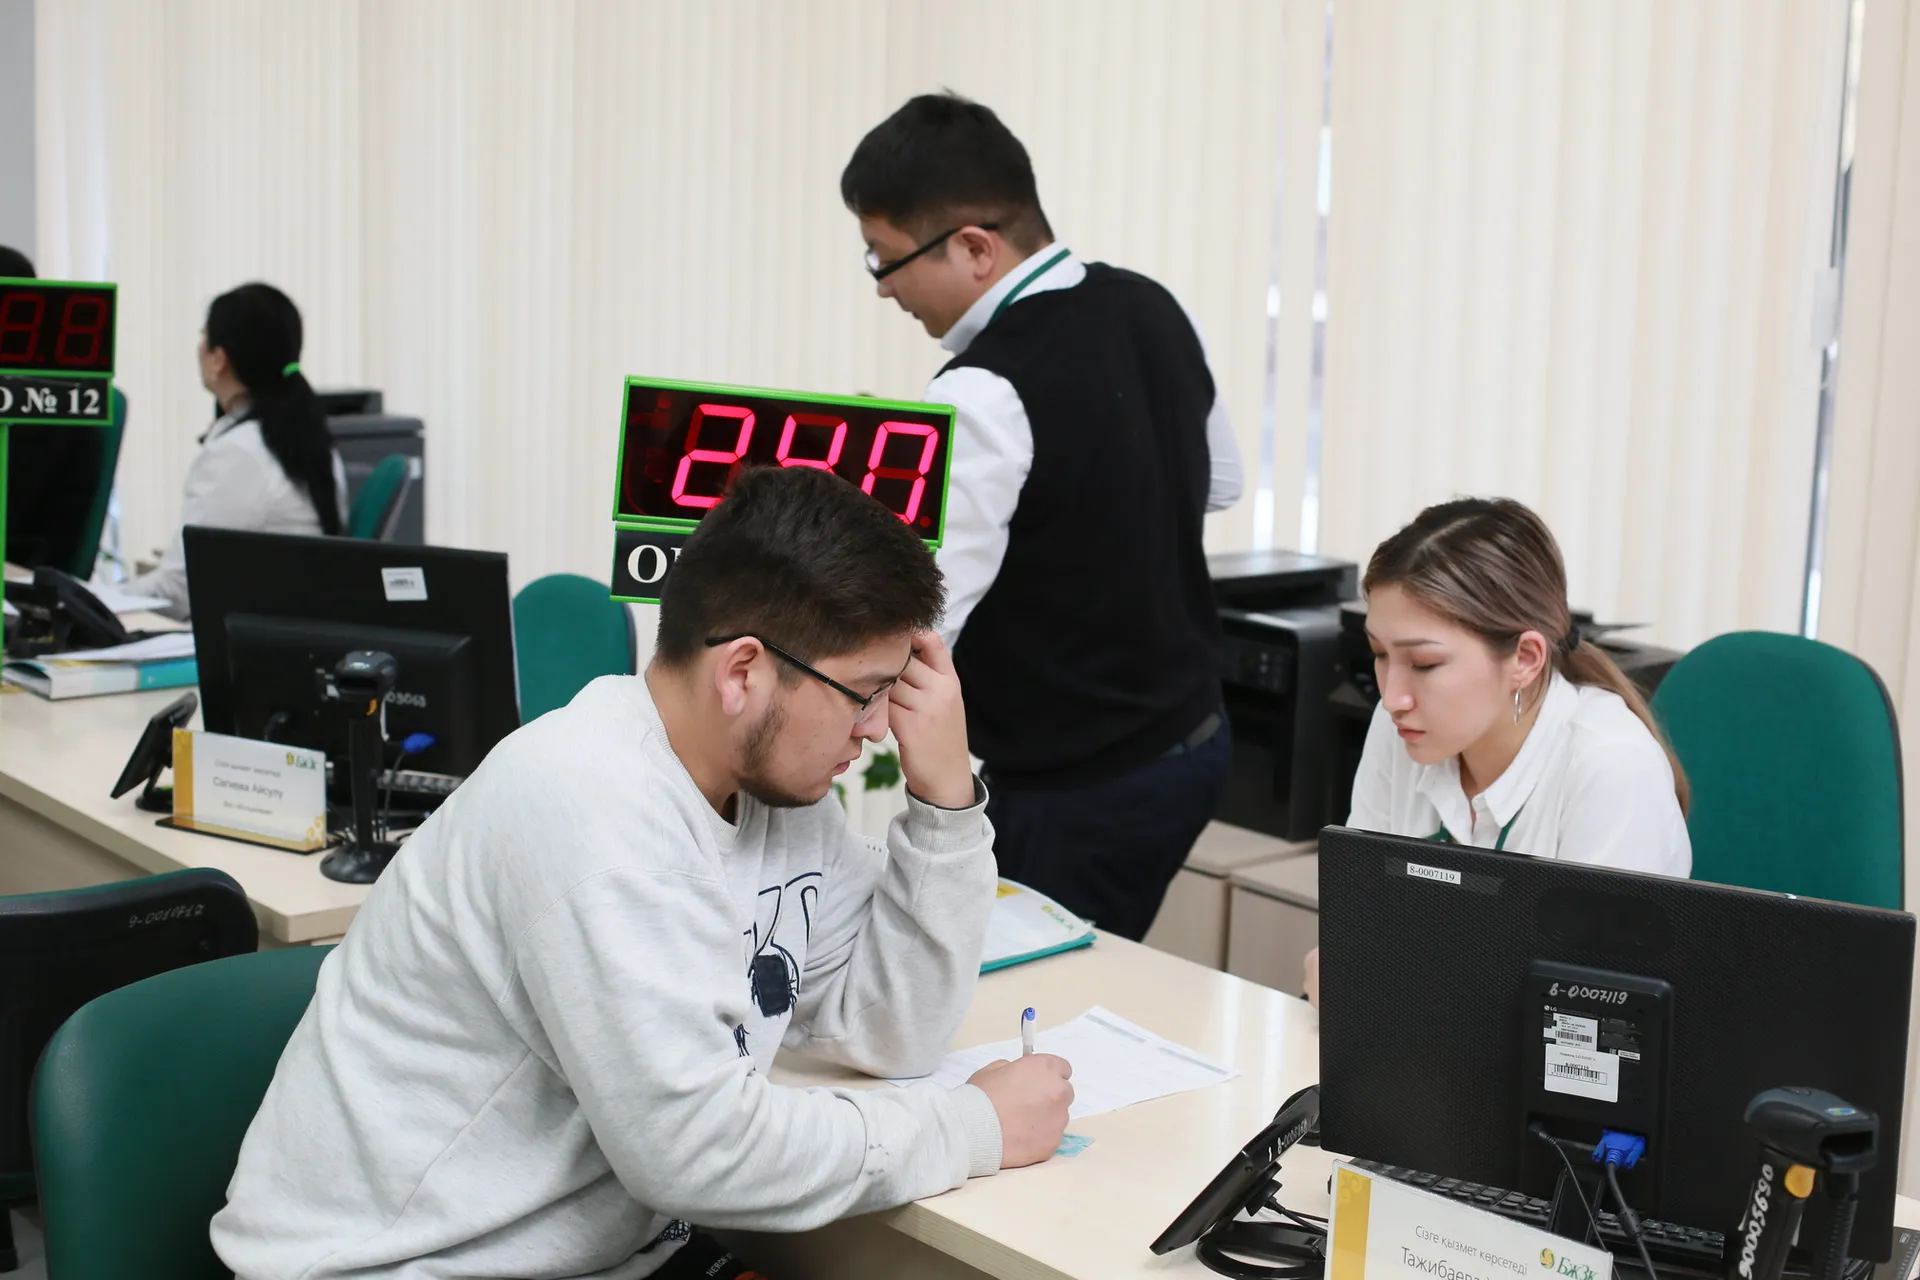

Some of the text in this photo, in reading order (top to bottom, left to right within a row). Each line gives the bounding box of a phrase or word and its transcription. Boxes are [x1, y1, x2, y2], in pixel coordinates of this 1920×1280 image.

[21, 388, 58, 414] №
[68, 389, 100, 414] 12
[1409, 866, 1455, 881] 8-0007119
[1415, 1225, 1528, 1276] Сізге қызмет көрсетеді
